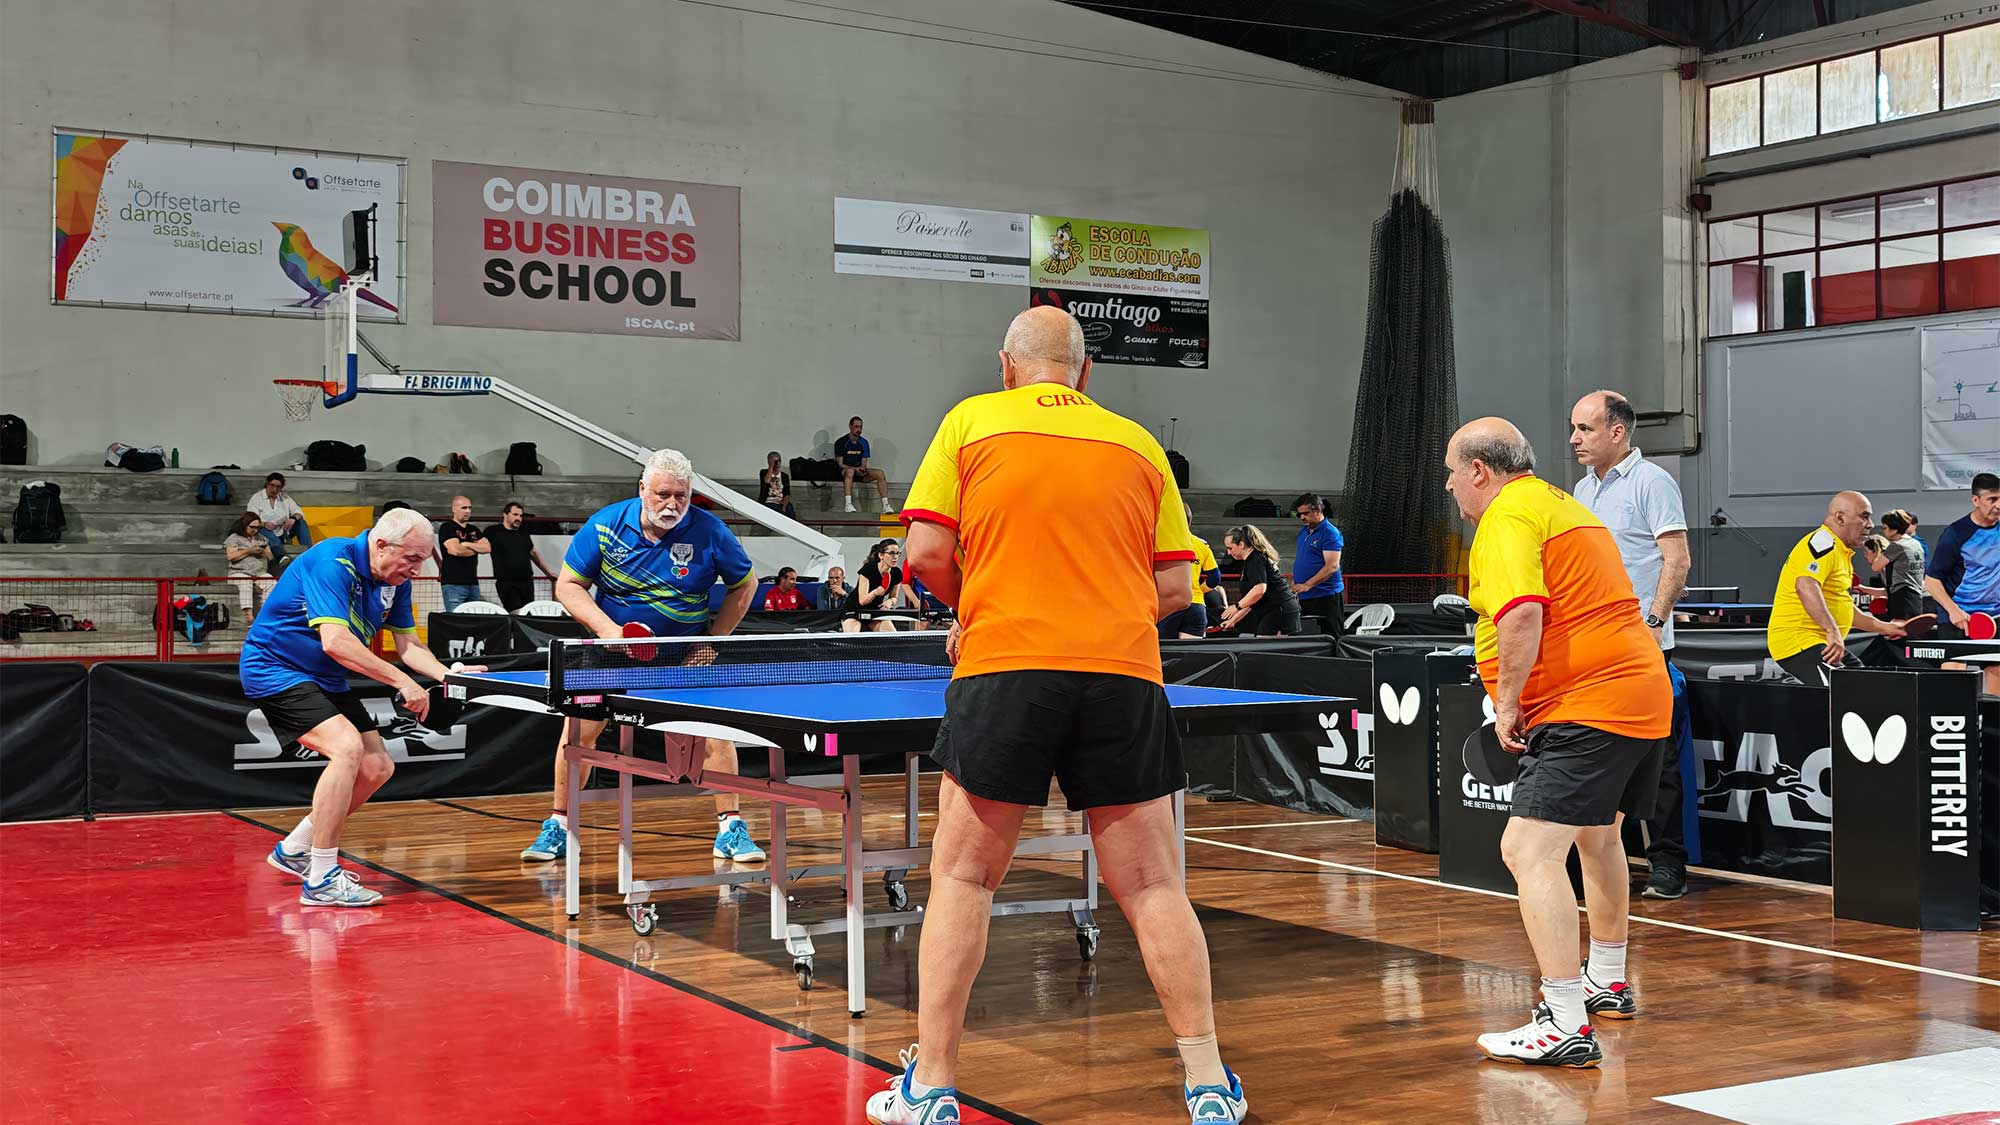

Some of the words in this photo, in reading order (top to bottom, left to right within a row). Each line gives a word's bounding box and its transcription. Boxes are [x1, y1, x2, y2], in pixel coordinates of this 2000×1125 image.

[128, 179, 143, 189] Na
[324, 175, 380, 188] Offsetarte
[135, 190, 240, 214] Offsetarte
[483, 177, 696, 227] COIMBRA
[120, 203, 192, 225] damos
[896, 209, 975, 239] Passerelle
[153, 224, 188, 237] asas
[1089, 225, 1151, 246] ESCOLA
[174, 239, 200, 249] suas
[201, 235, 263, 255] ideias!
[483, 218, 696, 265] BUSINESS
[1089, 245, 1111, 262] DE
[1114, 247, 1201, 271] CONDUÇÃO
[483, 258, 696, 308] SCHOOL
[1089, 265, 1201, 284] www.ecabadias.com
[149, 290, 233, 301] www.offsetarte.pt
[1067, 297, 1161, 328] santiago
[625, 316, 696, 333] ISCAC.pt
[1131, 336, 1158, 344] GIANT
[1168, 338, 1199, 346] FOCUS
[1913, 647, 1946, 659] BUTTERFLY
[1462, 772, 1514, 802] GEW
[1930, 715, 1968, 857] BUTTERFLY
[1462, 799, 1474, 808] THE
[1474, 801, 1496, 810] BETTER
